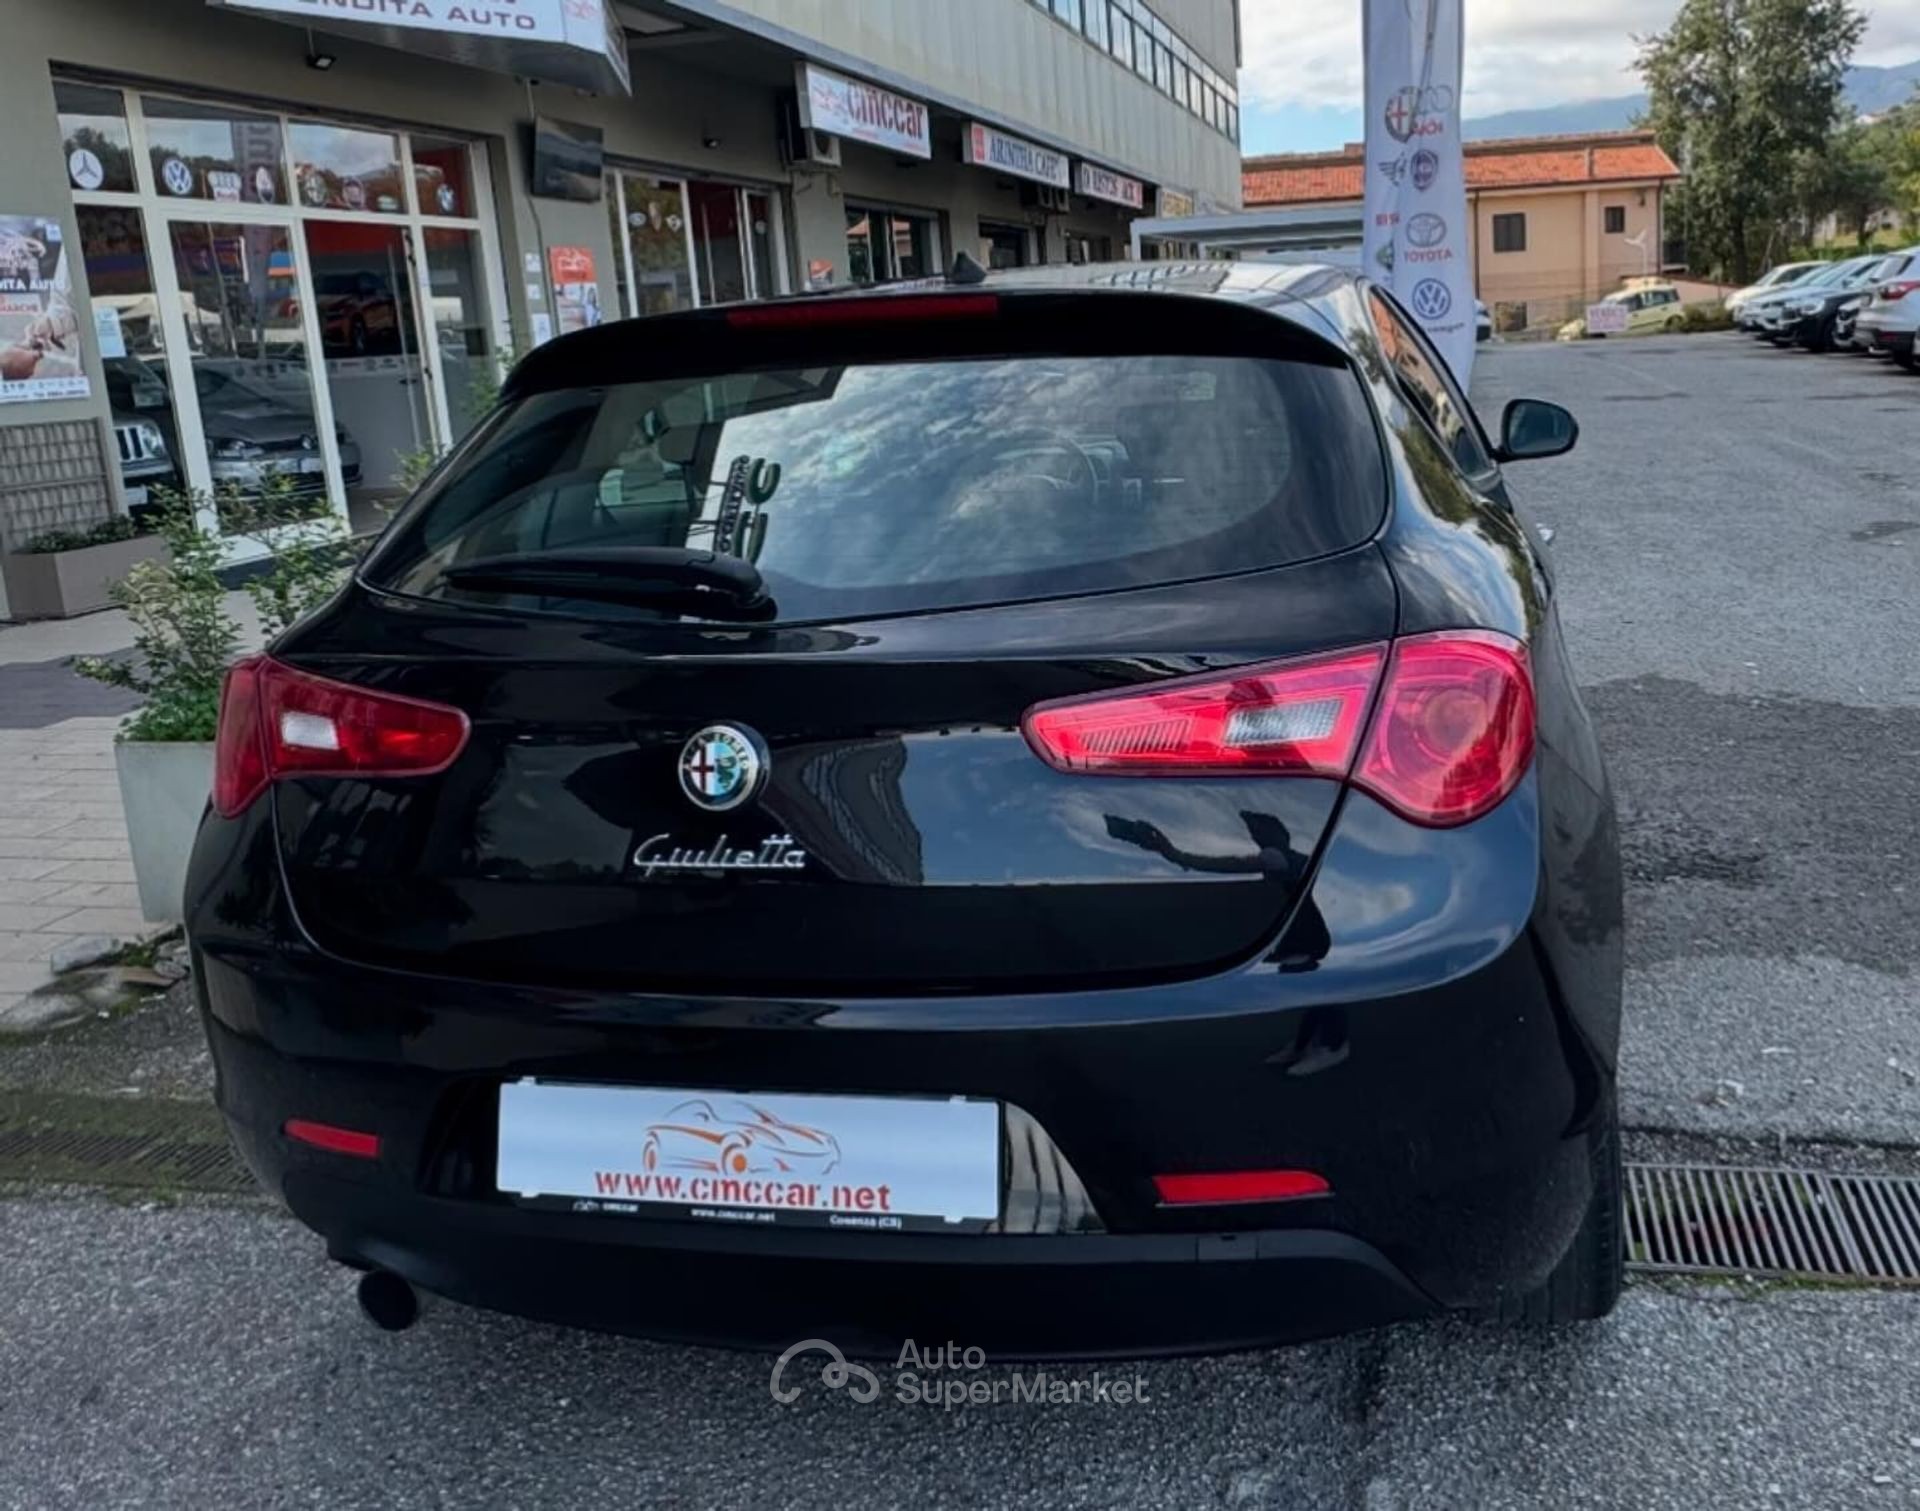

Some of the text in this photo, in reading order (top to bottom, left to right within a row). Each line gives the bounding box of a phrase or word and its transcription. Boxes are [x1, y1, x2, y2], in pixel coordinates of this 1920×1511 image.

[447, 6, 536, 30] AUTO
[1403, 248, 1453, 262] TOYOTA
[633, 833, 806, 878] Giulietta
